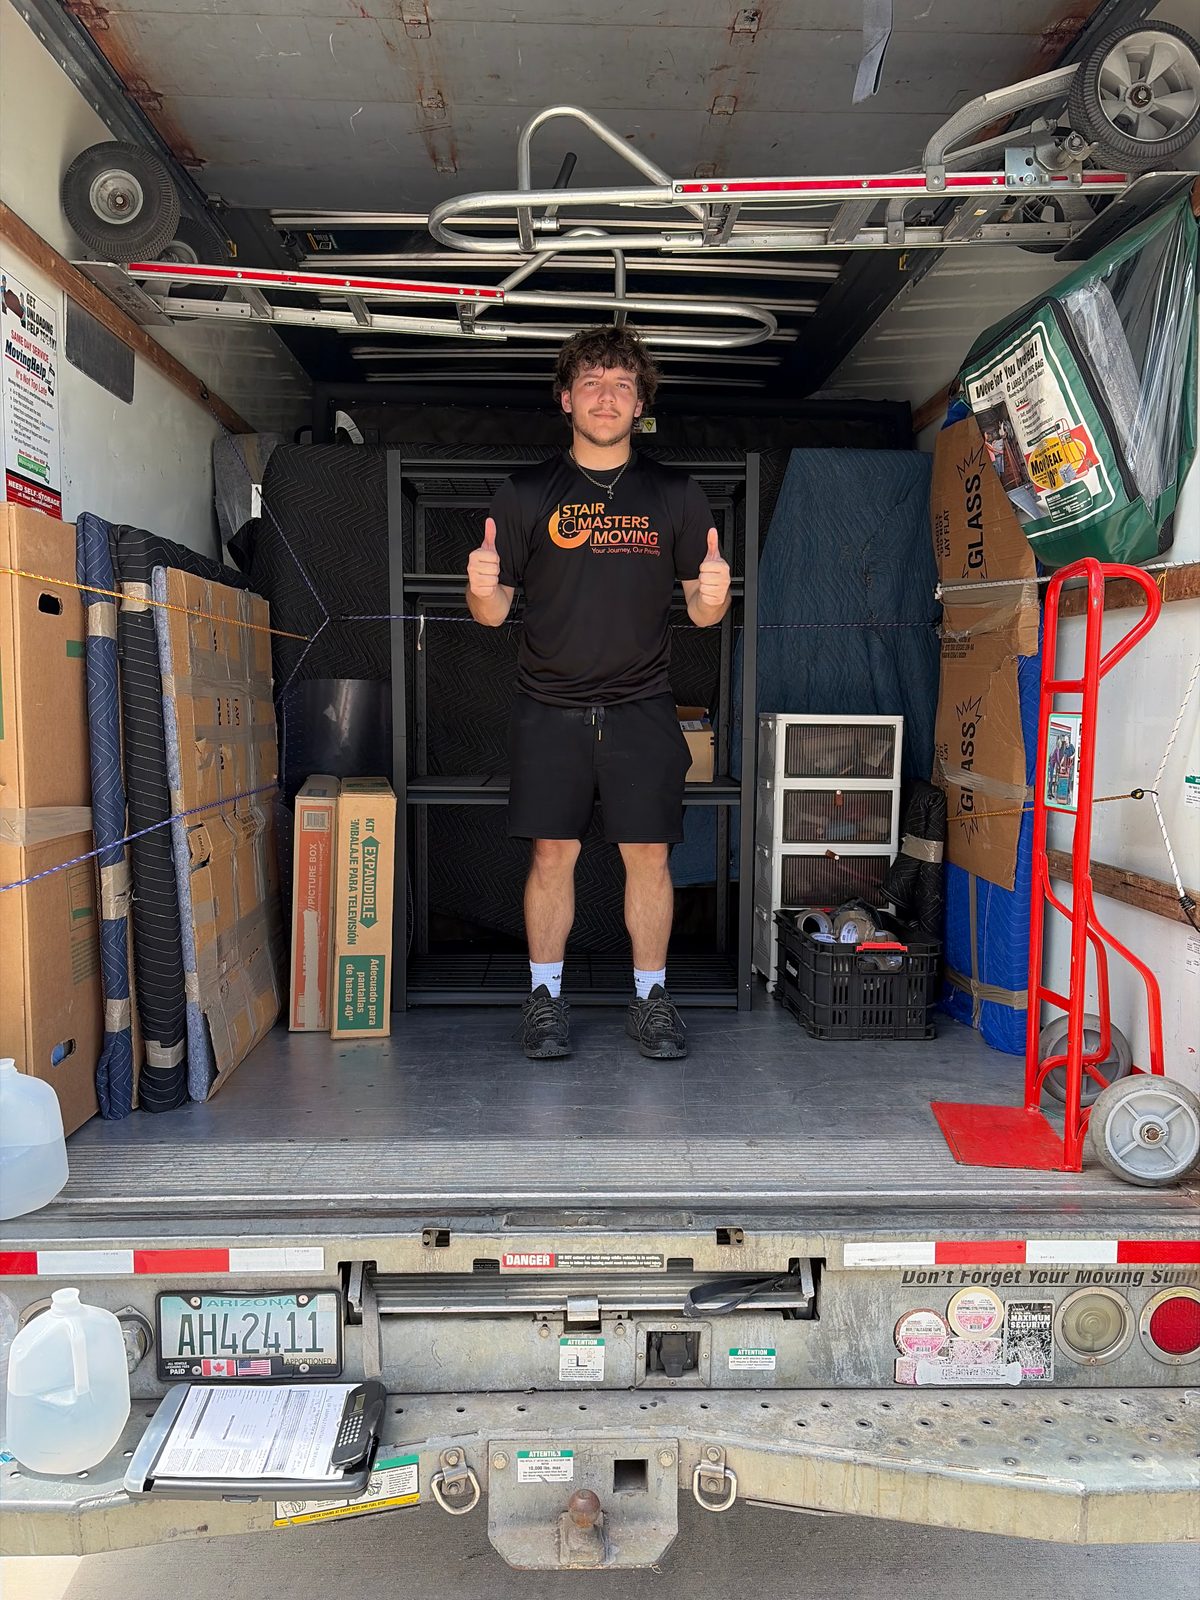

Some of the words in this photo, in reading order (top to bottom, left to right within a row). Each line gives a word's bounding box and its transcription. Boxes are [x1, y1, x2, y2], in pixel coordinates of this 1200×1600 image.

[11, 329, 24, 347] SAME
[32, 342, 49, 364] SERVICE
[1034, 357, 1045, 372] BAG
[22, 372, 31, 386] Not
[38, 384, 48, 397] Late
[8, 479, 23, 493] NEED
[562, 502, 606, 518] STAIR
[578, 516, 650, 530] MASTERS
[965, 473, 984, 570] GLASS
[593, 529, 659, 546] MOVING
[607, 547, 632, 555] Journey,
[644, 547, 661, 557] Priority
[365, 818, 375, 833] KIT
[349, 819, 359, 866] MBALAJE
[309, 843, 317, 863] BOX
[348, 866, 358, 893] PARA
[362, 846, 377, 919] EXPANDIBLE
[347, 894, 359, 946] TELEVISIÓN
[345, 963, 355, 976] de
[345, 977, 355, 1003] hasta
[369, 958, 380, 1003] Adecuado
[356, 971, 367, 1014] pantallas
[367, 1005, 376, 1026] para
[506, 1254, 550, 1266] DANGER
[902, 1270, 954, 1284] Don't
[959, 1270, 1021, 1287] Forget
[1028, 1270, 1070, 1284] Your
[1074, 1270, 1145, 1287] Moving
[206, 1297, 297, 1308] ARIZONA
[177, 1311, 325, 1356] AH42411
[1010, 1321, 1051, 1329] SECURITY
